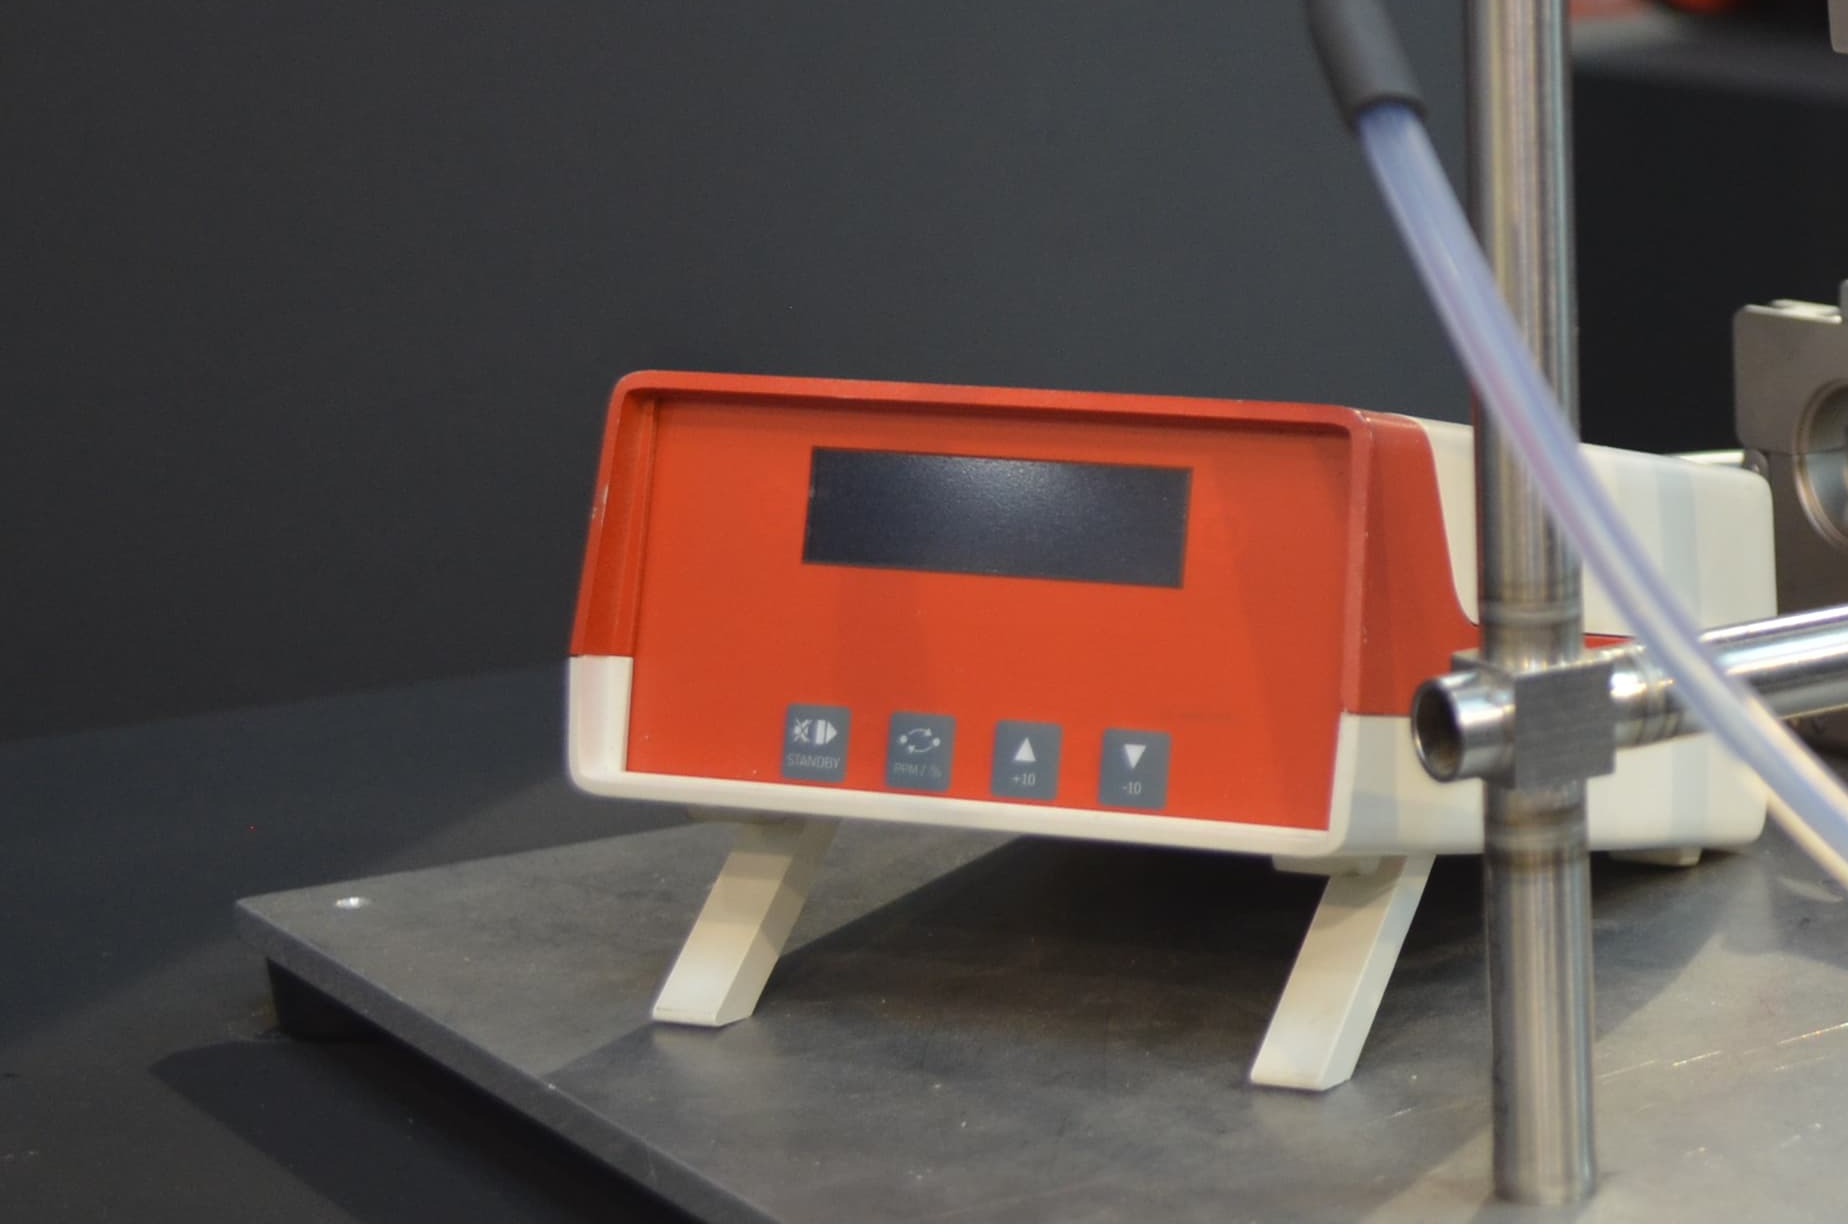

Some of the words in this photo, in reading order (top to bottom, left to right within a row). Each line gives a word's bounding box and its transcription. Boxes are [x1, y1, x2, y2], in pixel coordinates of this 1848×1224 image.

[787, 753, 840, 769] STANDBY
[1012, 772, 1036, 786] +10
[1121, 781, 1142, 795] -10
